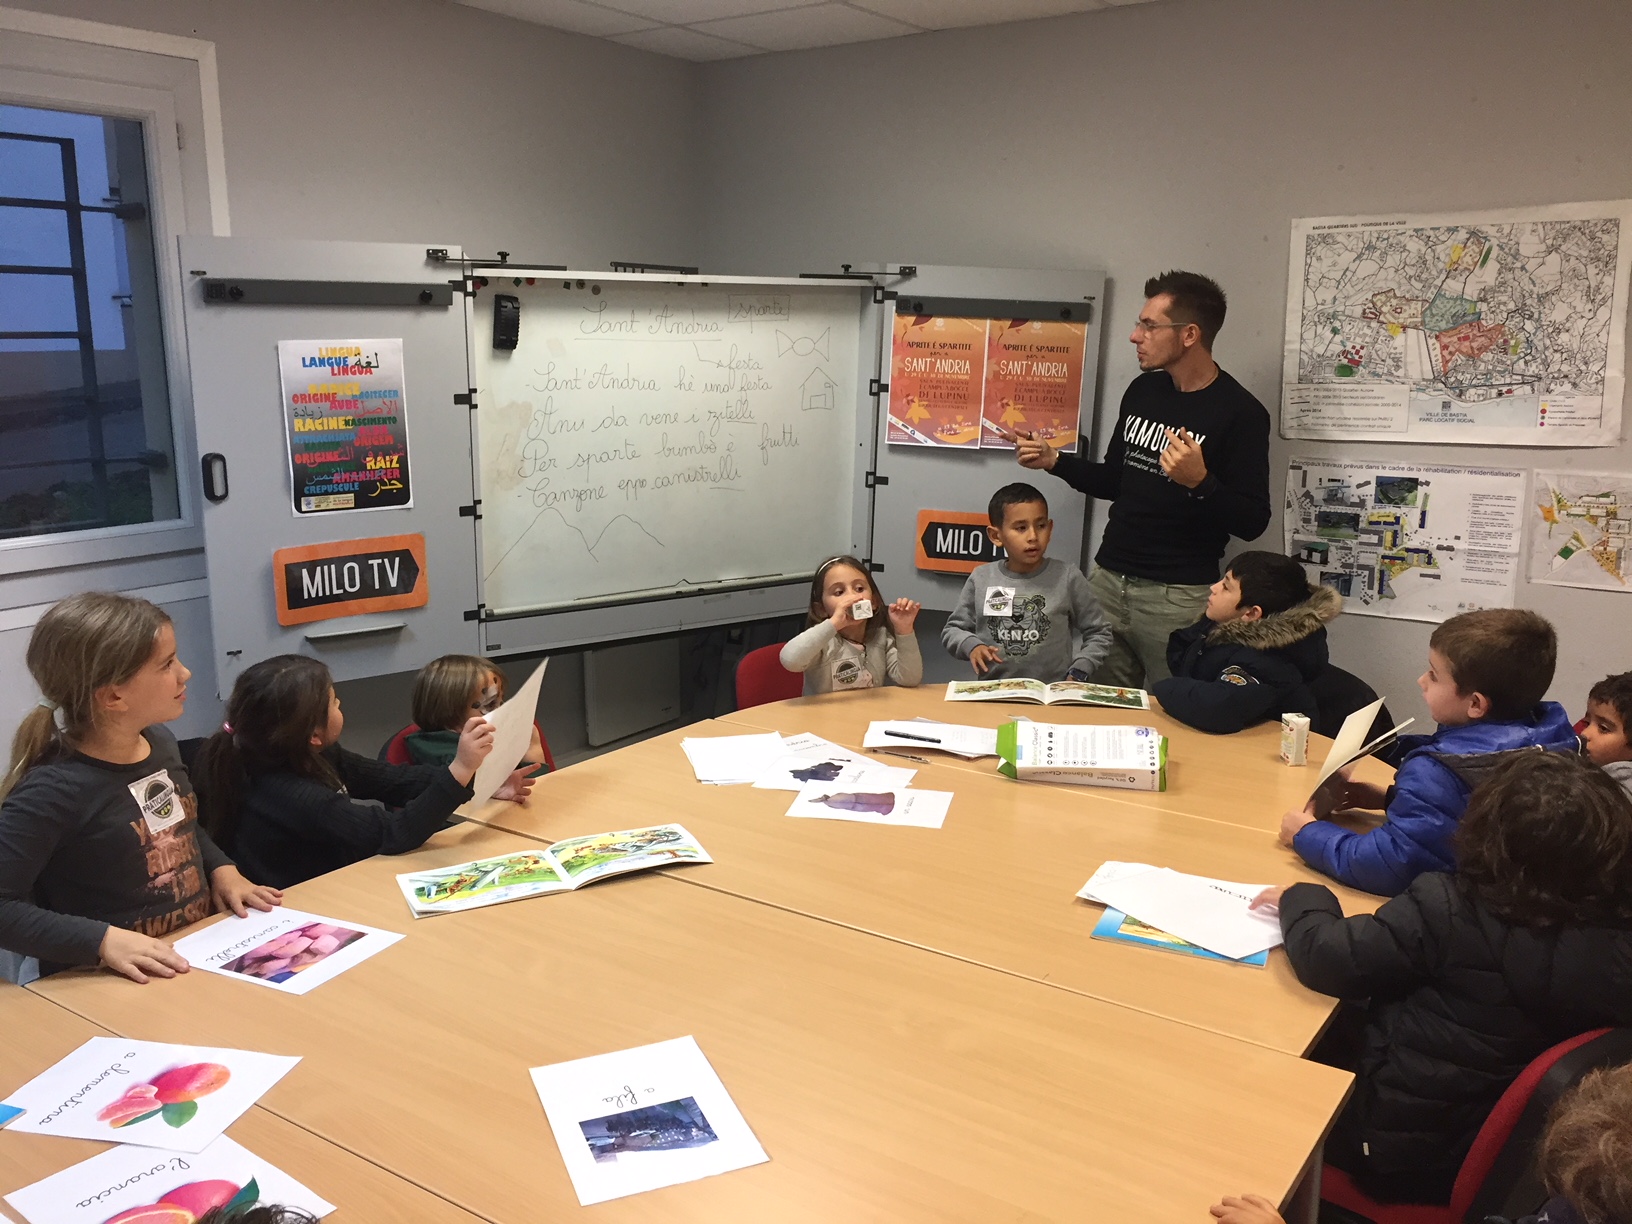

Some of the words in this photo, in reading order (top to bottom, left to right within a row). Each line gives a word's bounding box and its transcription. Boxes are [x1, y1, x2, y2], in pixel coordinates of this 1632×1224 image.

[302, 356, 349, 368] LANGUE
[331, 364, 373, 376] LINGUA
[292, 392, 338, 404] ORIGINE
[330, 399, 359, 410] AUBE
[591, 406, 628, 432] da
[1467, 469, 1520, 478] résidentialisation
[304, 482, 360, 494] CREPUSCULE
[936, 528, 983, 556] MILO
[302, 562, 361, 600] MILO
[368, 557, 400, 590] TV
[997, 630, 1039, 641] KENZO
[39, 1063, 130, 1126] clementina
[602, 1085, 638, 1108] fila
[75, 1157, 190, 1208] l'arancia
